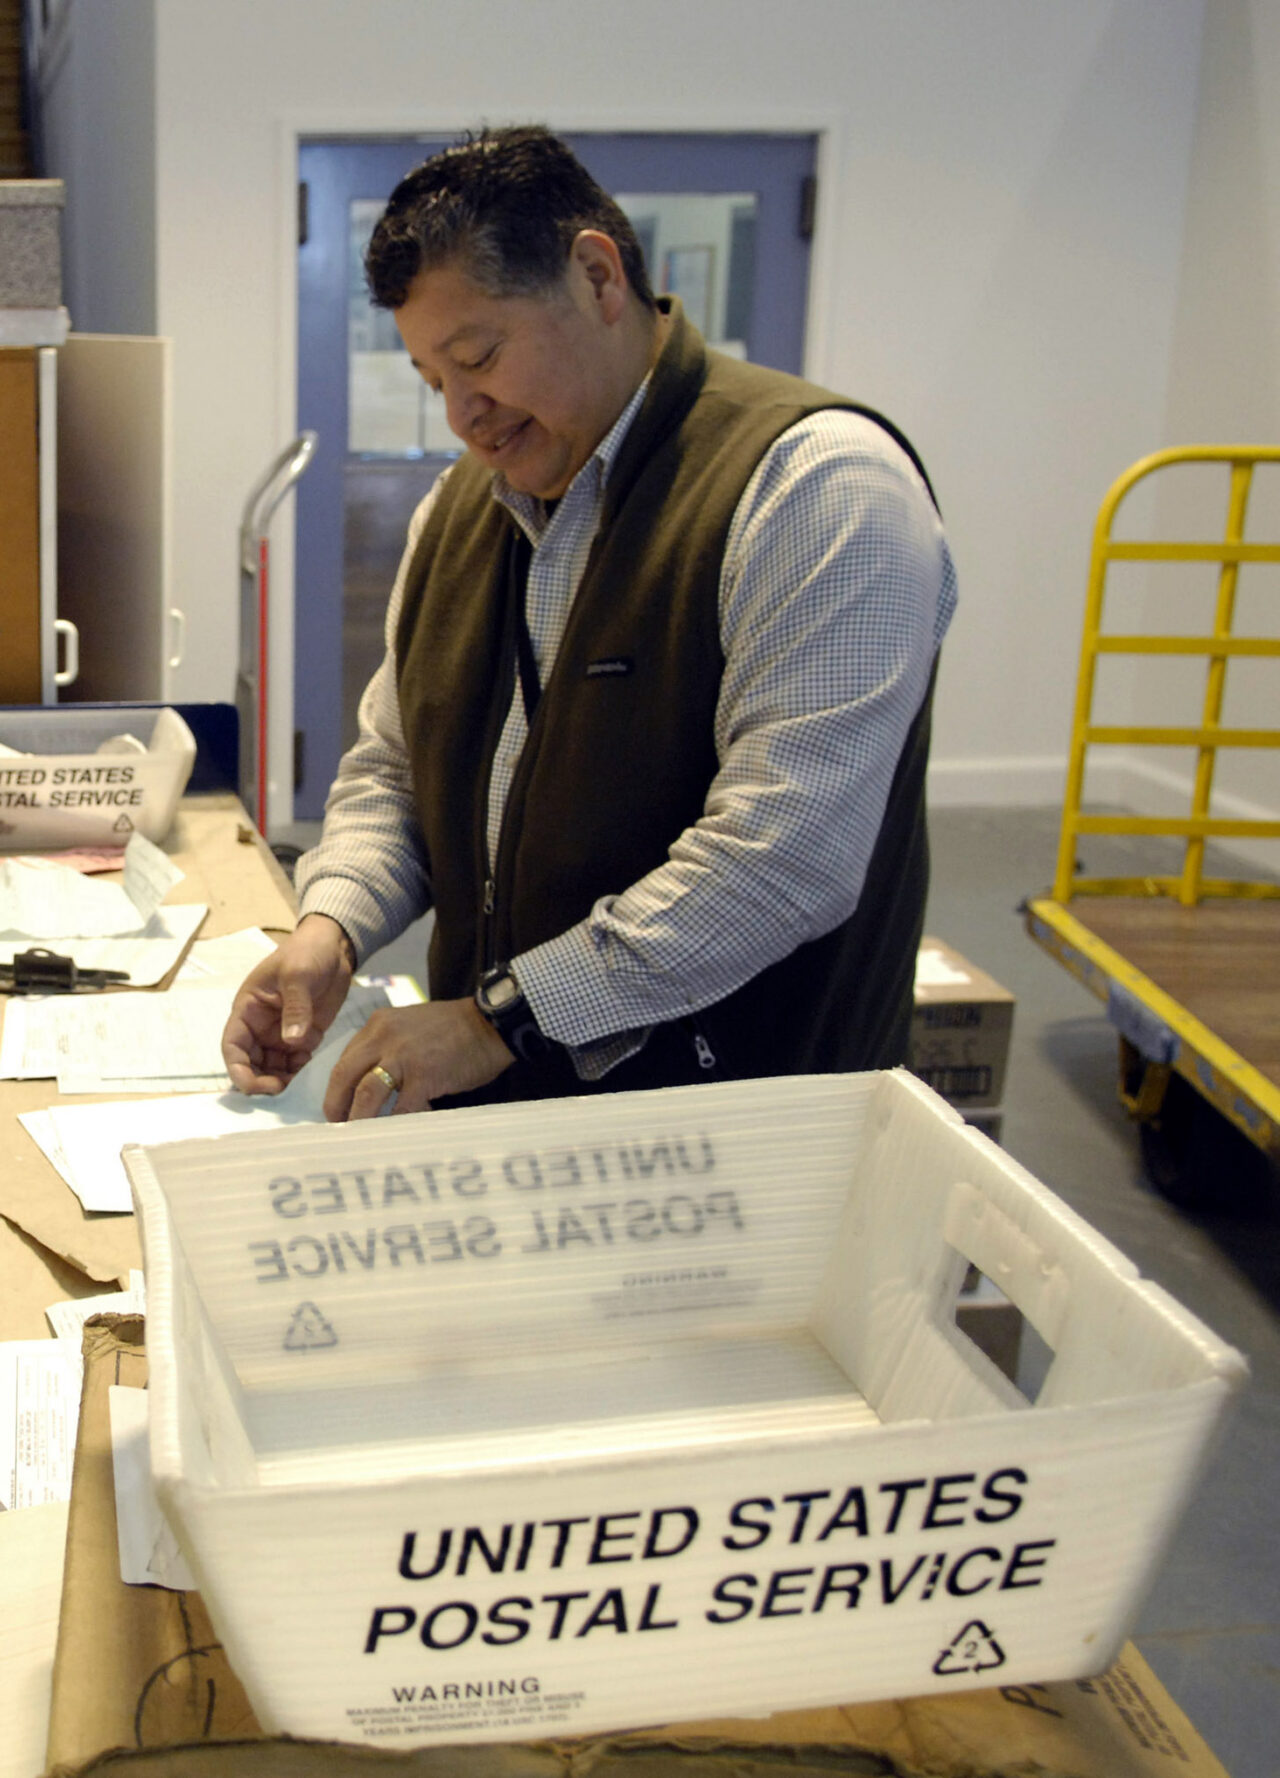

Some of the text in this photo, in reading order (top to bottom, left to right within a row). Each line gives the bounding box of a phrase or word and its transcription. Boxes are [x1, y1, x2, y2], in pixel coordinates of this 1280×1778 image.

[52, 766, 135, 785] STATES
[48, 788, 144, 807] SERVICE
[397, 1467, 1029, 1581] UNITED STATES
[365, 1539, 1057, 1655] POSTAL SERVICE
[963, 1641, 978, 1658] 2
[392, 1677, 540, 1704] WARNING
